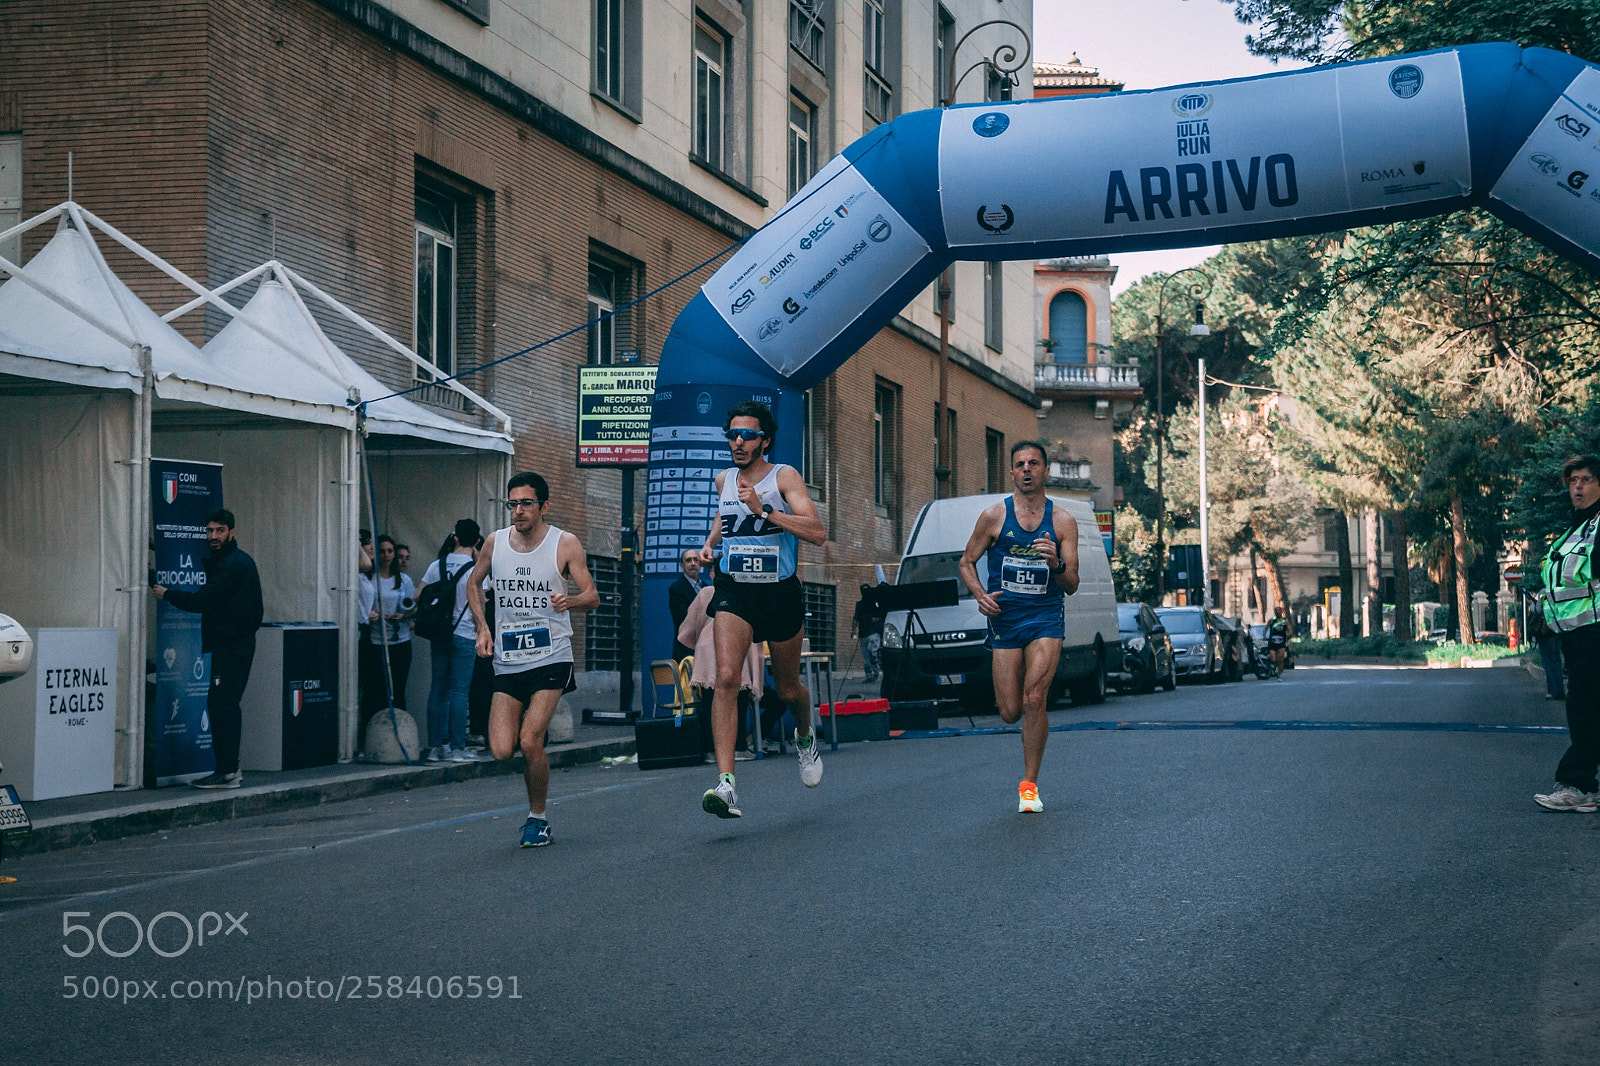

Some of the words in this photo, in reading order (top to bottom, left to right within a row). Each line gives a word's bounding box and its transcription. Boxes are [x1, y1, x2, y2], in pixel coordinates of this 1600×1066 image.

[1177, 122, 1210, 137] IULIA
[1177, 136, 1211, 157] RUN
[1361, 168, 1405, 182] ROMA
[1104, 153, 1300, 224] ARRIVO
[808, 216, 833, 239] BCC
[603, 396, 648, 404] RECUPERO
[596, 431, 623, 439] TUTTO
[178, 473, 197, 483] CONI
[180, 554, 193, 568] LA
[742, 557, 763, 572] 28
[515, 567, 531, 575] SOLO
[1016, 570, 1035, 585] 64
[496, 579, 552, 592] ETERNAL
[499, 596, 548, 609] EAGLES
[515, 633, 535, 650] 76
[932, 632, 966, 642] IVECO
[45, 667, 109, 690] ETERNAL
[303, 680, 321, 690] CONI
[49, 692, 105, 715] EAGLES
